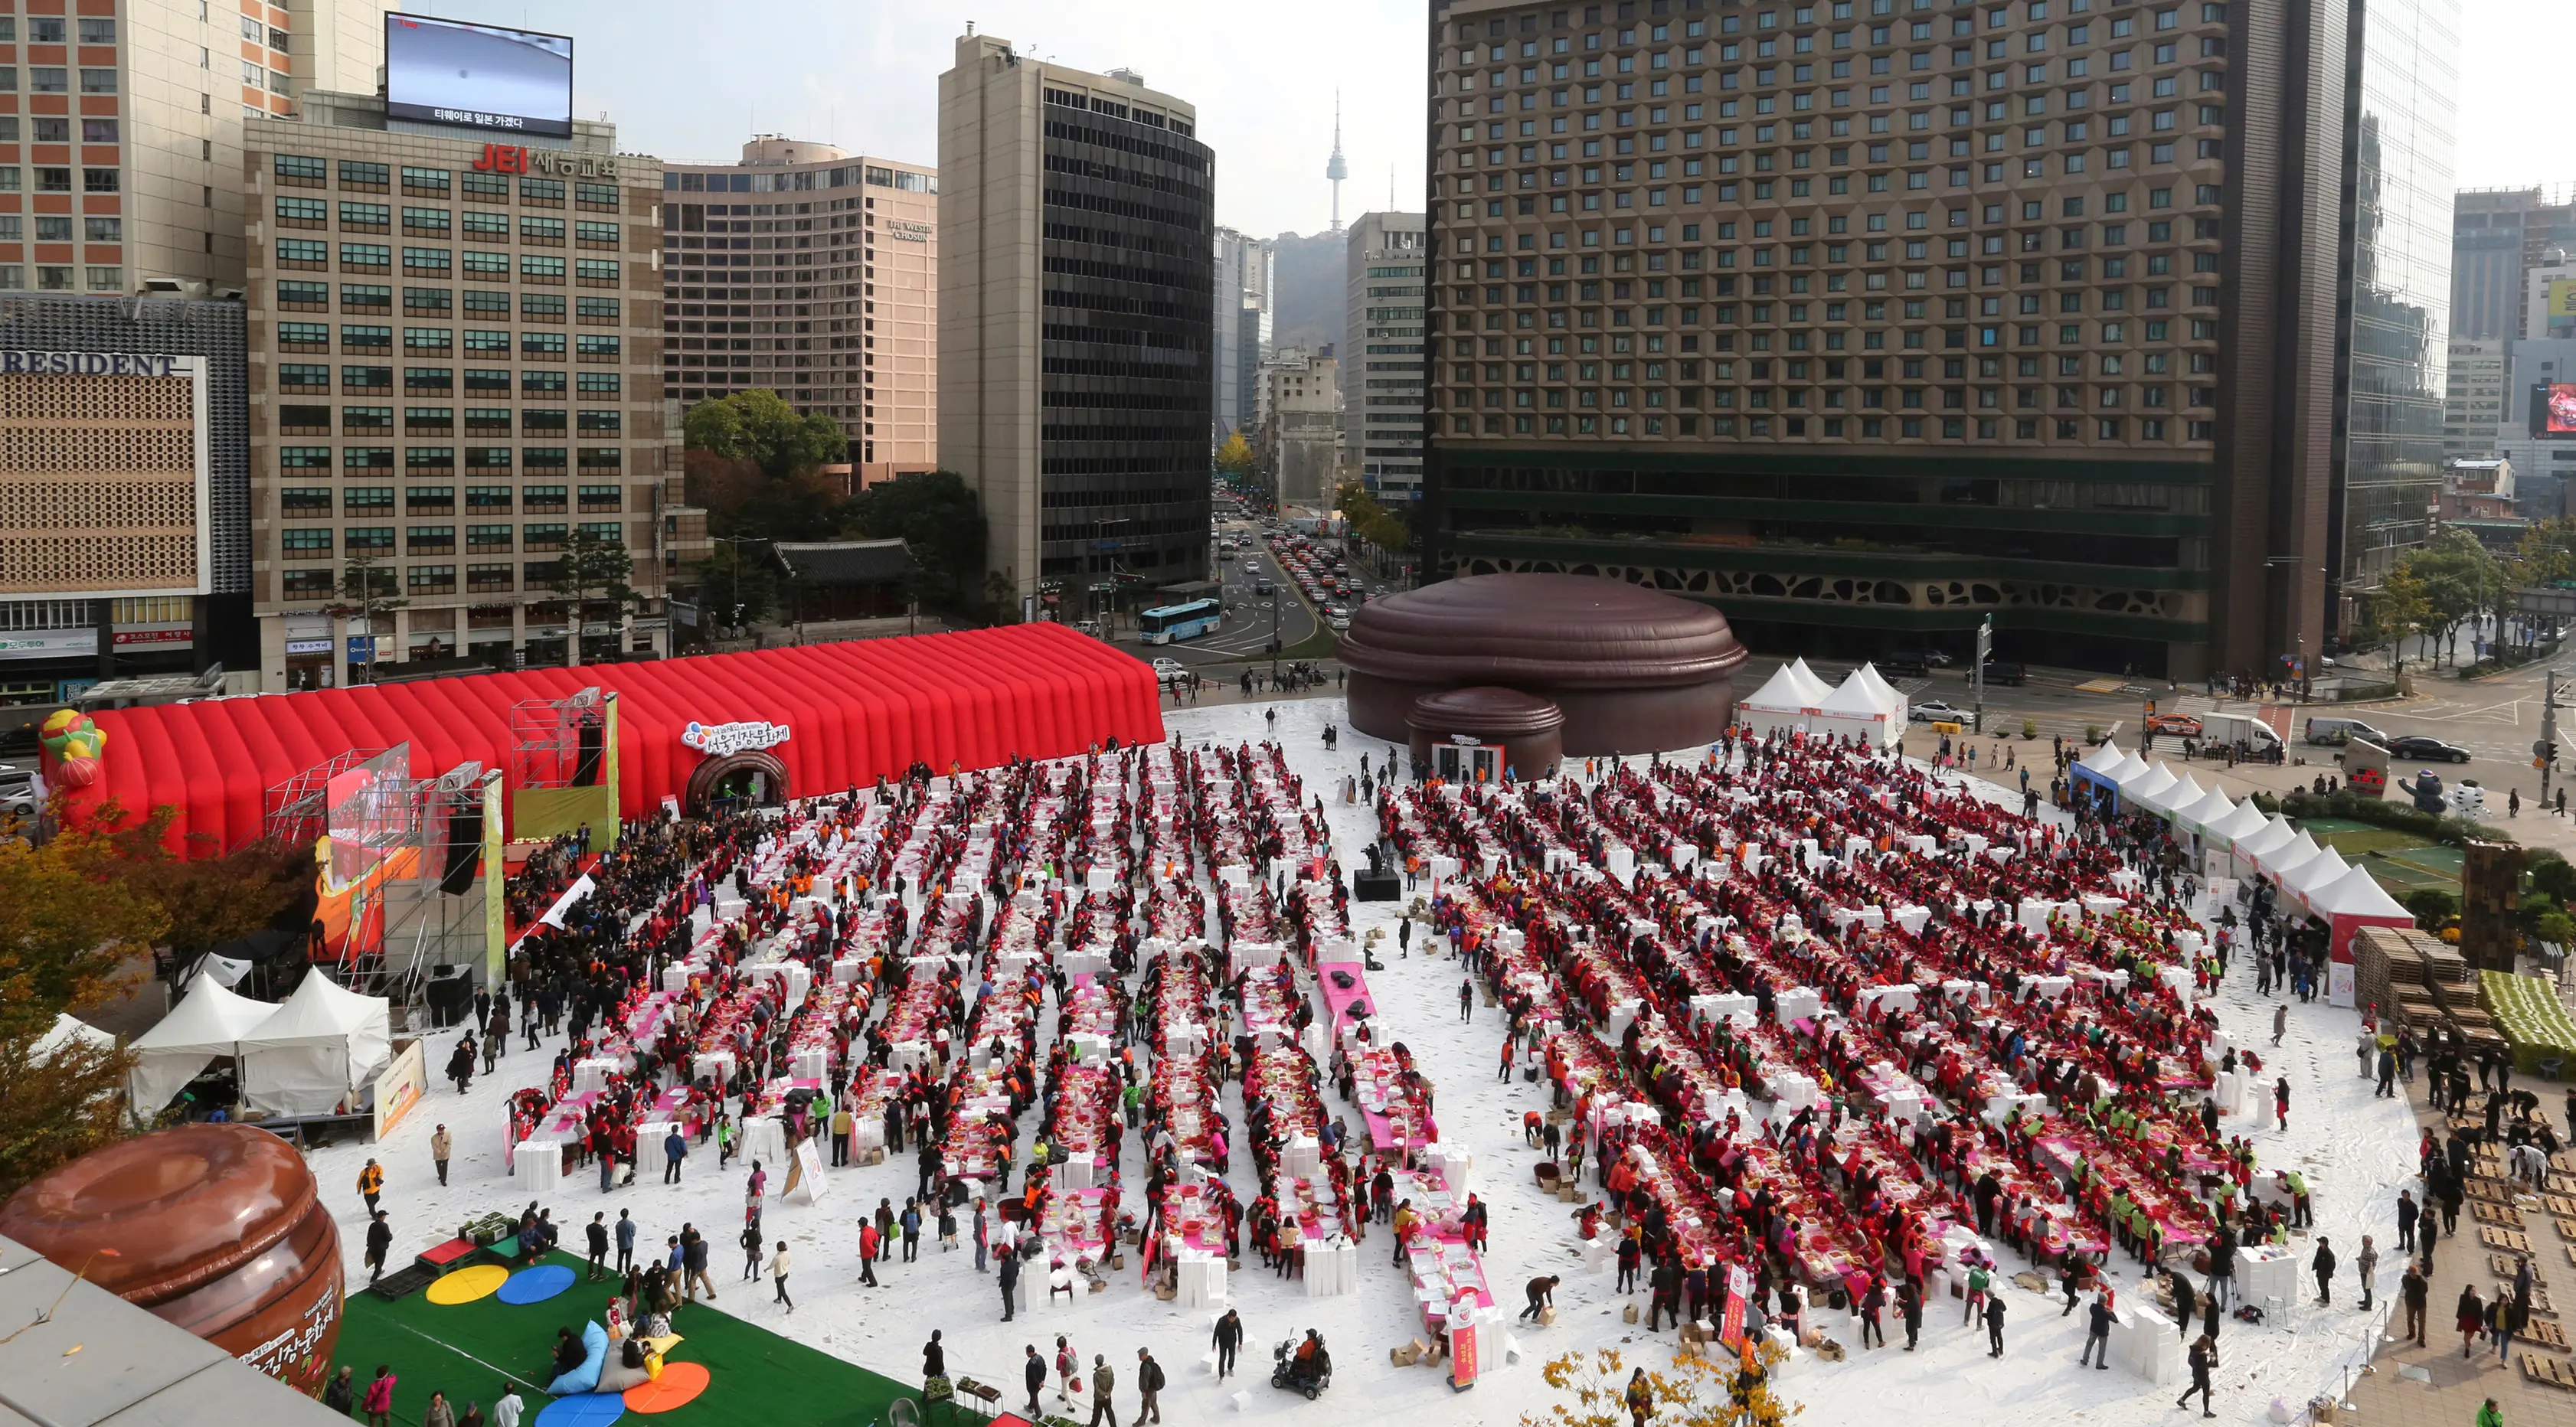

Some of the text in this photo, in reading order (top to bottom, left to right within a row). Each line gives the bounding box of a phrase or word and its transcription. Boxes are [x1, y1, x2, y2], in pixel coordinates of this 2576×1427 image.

[434, 109, 524, 129] 티웨이로 일본 가겠다
[473, 143, 528, 174] JEI
[534, 149, 619, 181] 재능교육
[894, 230, 928, 242] CHOSUN
[2, 350, 177, 377] RESIDENT
[8, 640, 44, 650] 모두투어
[708, 723, 789, 754] 서울김장문화제
[252, 1303, 334, 1376] 김장문화제
